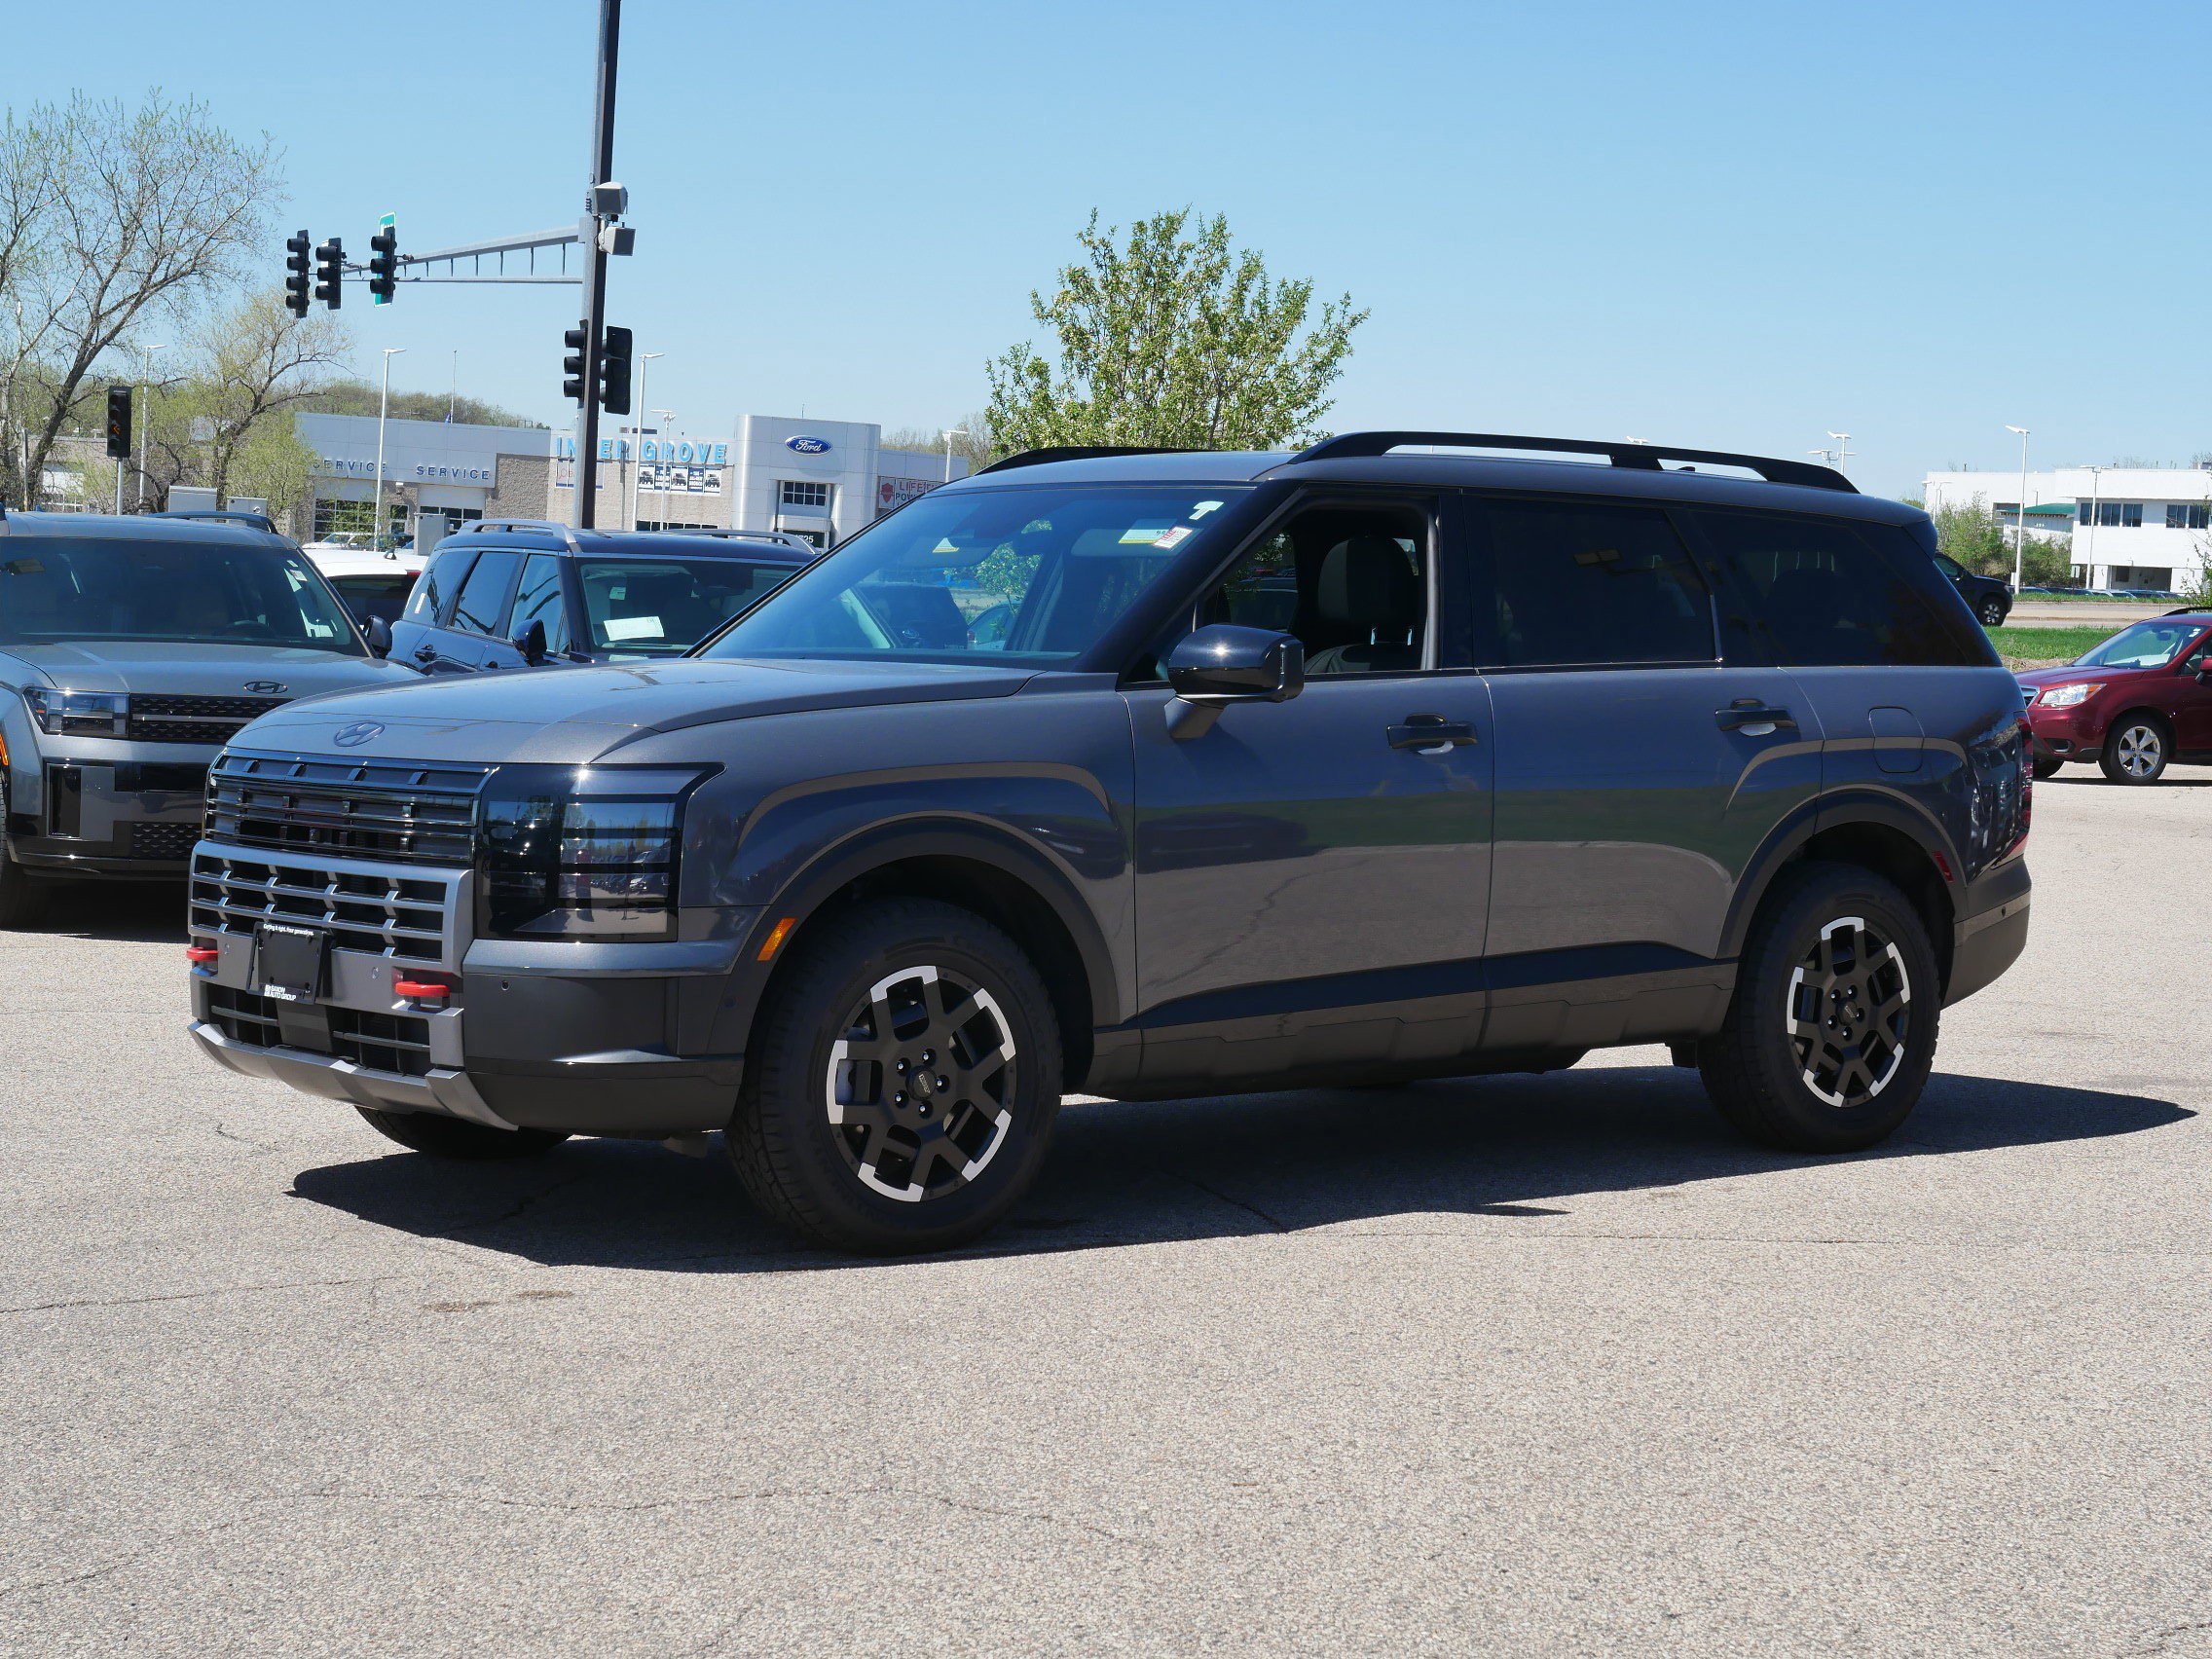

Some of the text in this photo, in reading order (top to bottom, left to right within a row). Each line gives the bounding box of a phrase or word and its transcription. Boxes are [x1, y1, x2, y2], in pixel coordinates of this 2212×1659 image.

[556, 436, 727, 464] INER GROVE
[794, 439, 823, 453] Ford
[416, 465, 490, 480] SERVICE
